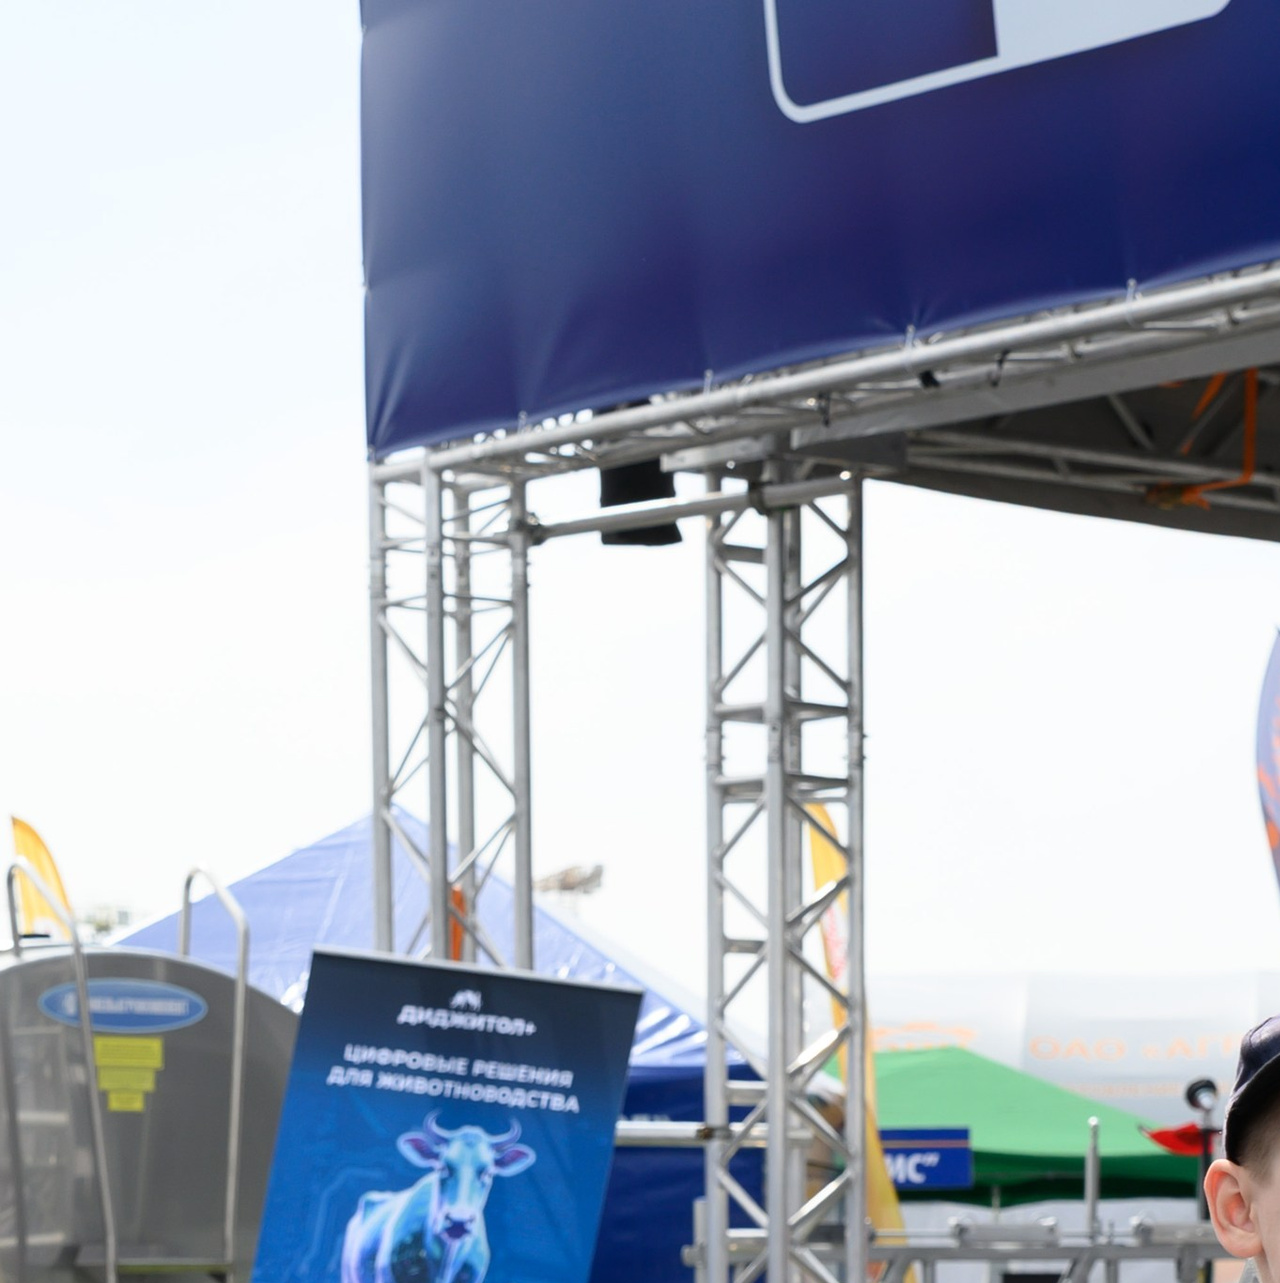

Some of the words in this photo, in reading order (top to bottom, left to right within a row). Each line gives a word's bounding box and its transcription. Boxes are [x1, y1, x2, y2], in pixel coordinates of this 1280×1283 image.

[344, 1044, 469, 1076] ЦИФРОВЫЕ
[472, 1059, 574, 1088] РЕШЕНИЯ
[1029, 1035, 1126, 1062] ОАО
[326, 1065, 374, 1088] ДЛЯ
[376, 1070, 580, 1113] ЖИВОТНОВОДСТВА
